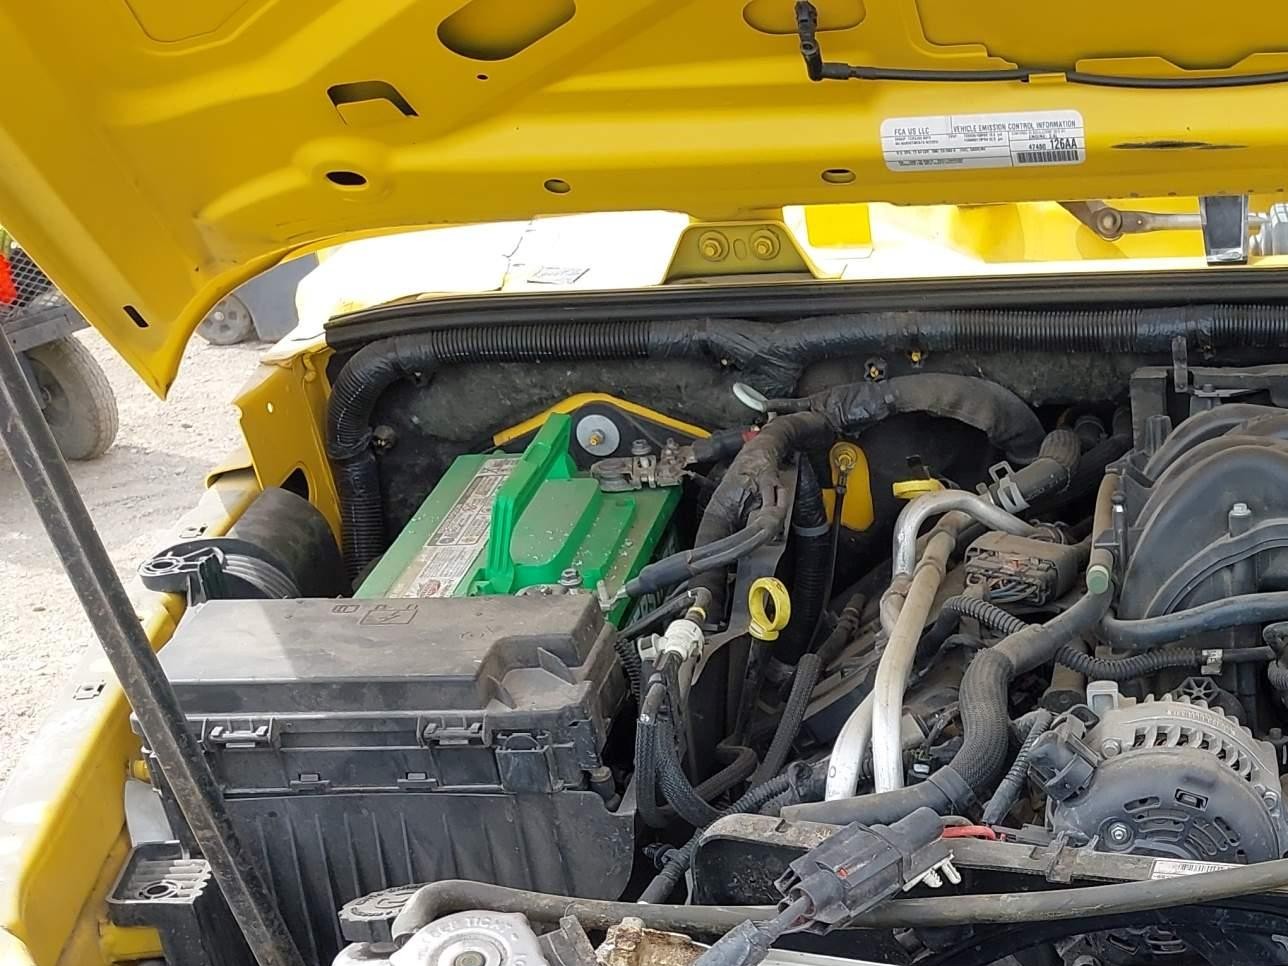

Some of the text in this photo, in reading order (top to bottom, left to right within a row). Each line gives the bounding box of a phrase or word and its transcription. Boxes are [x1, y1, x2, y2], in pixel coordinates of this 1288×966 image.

[894, 127, 930, 136] FCA US LLC
[953, 120, 1076, 133] VEHICLE EMISSION CONTROL INFORMATION
[1050, 138, 1077, 150] 126AA
